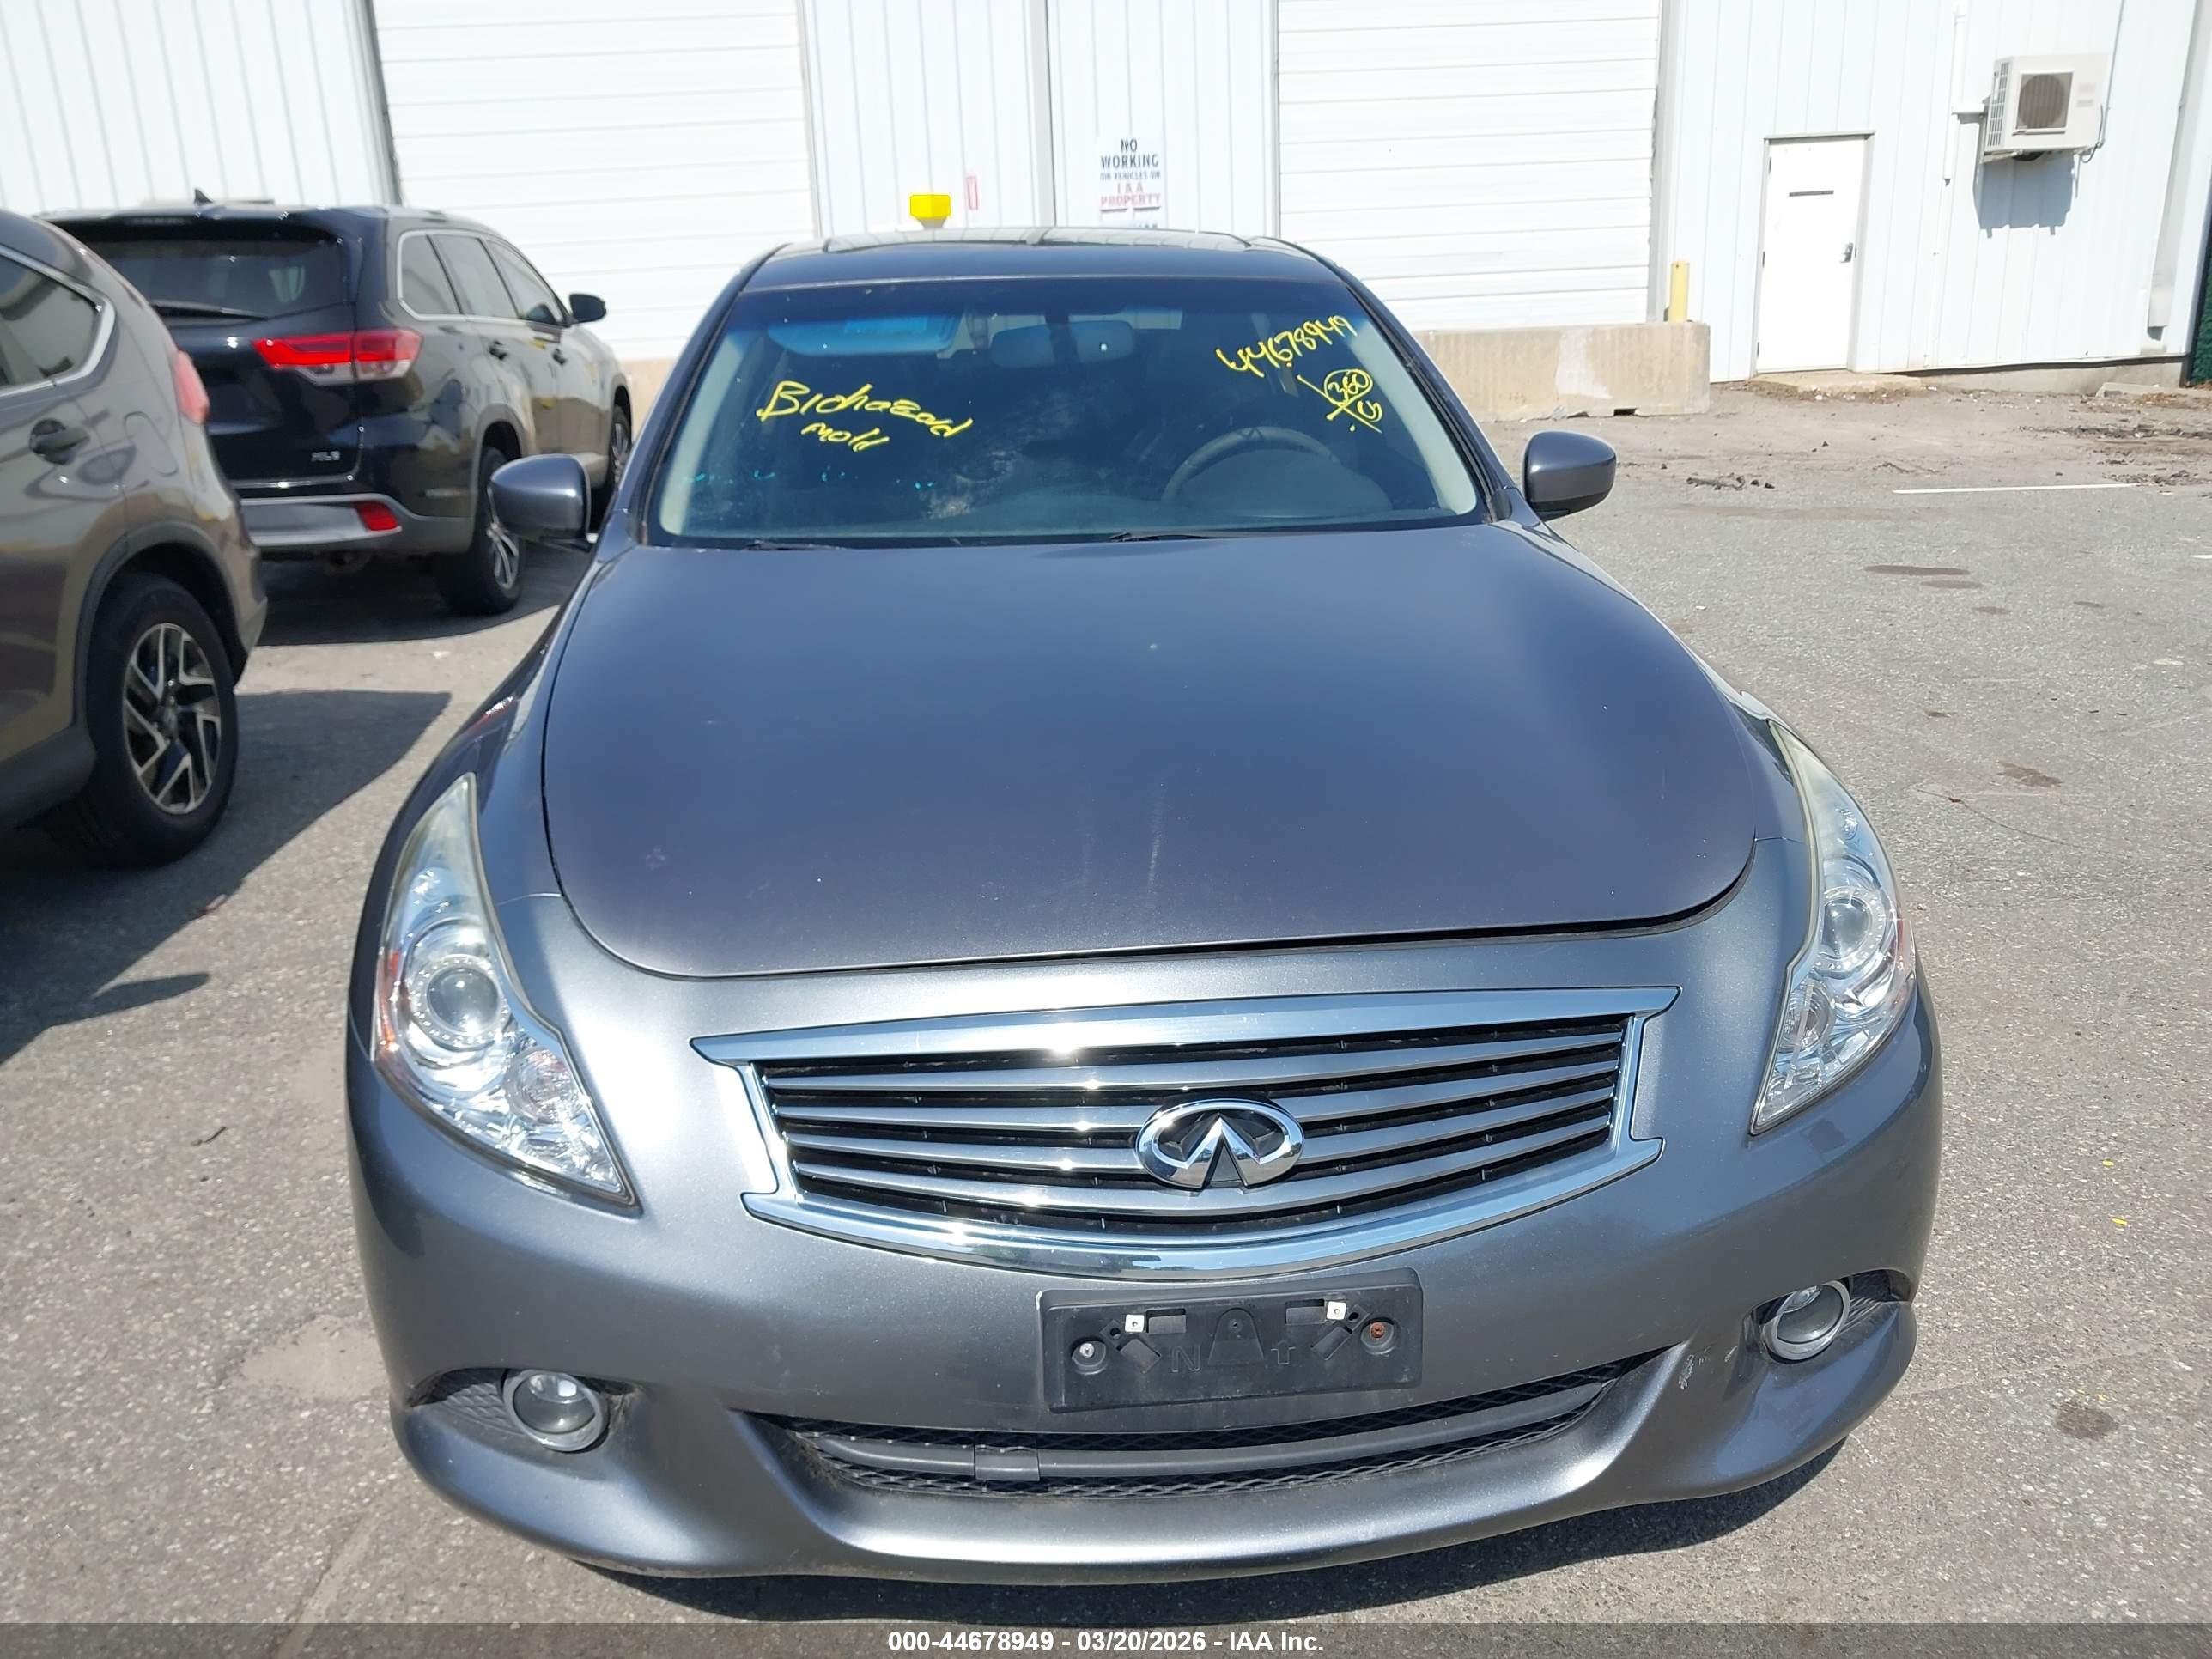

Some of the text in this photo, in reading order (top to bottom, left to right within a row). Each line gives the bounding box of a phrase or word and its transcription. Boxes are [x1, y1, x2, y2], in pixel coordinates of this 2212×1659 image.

[1121, 137, 1138, 153] NO
[1100, 154, 1159, 169] WORKING
[1100, 193, 1161, 206] PROPERTY
[1215, 314, 1358, 379] 44678949
